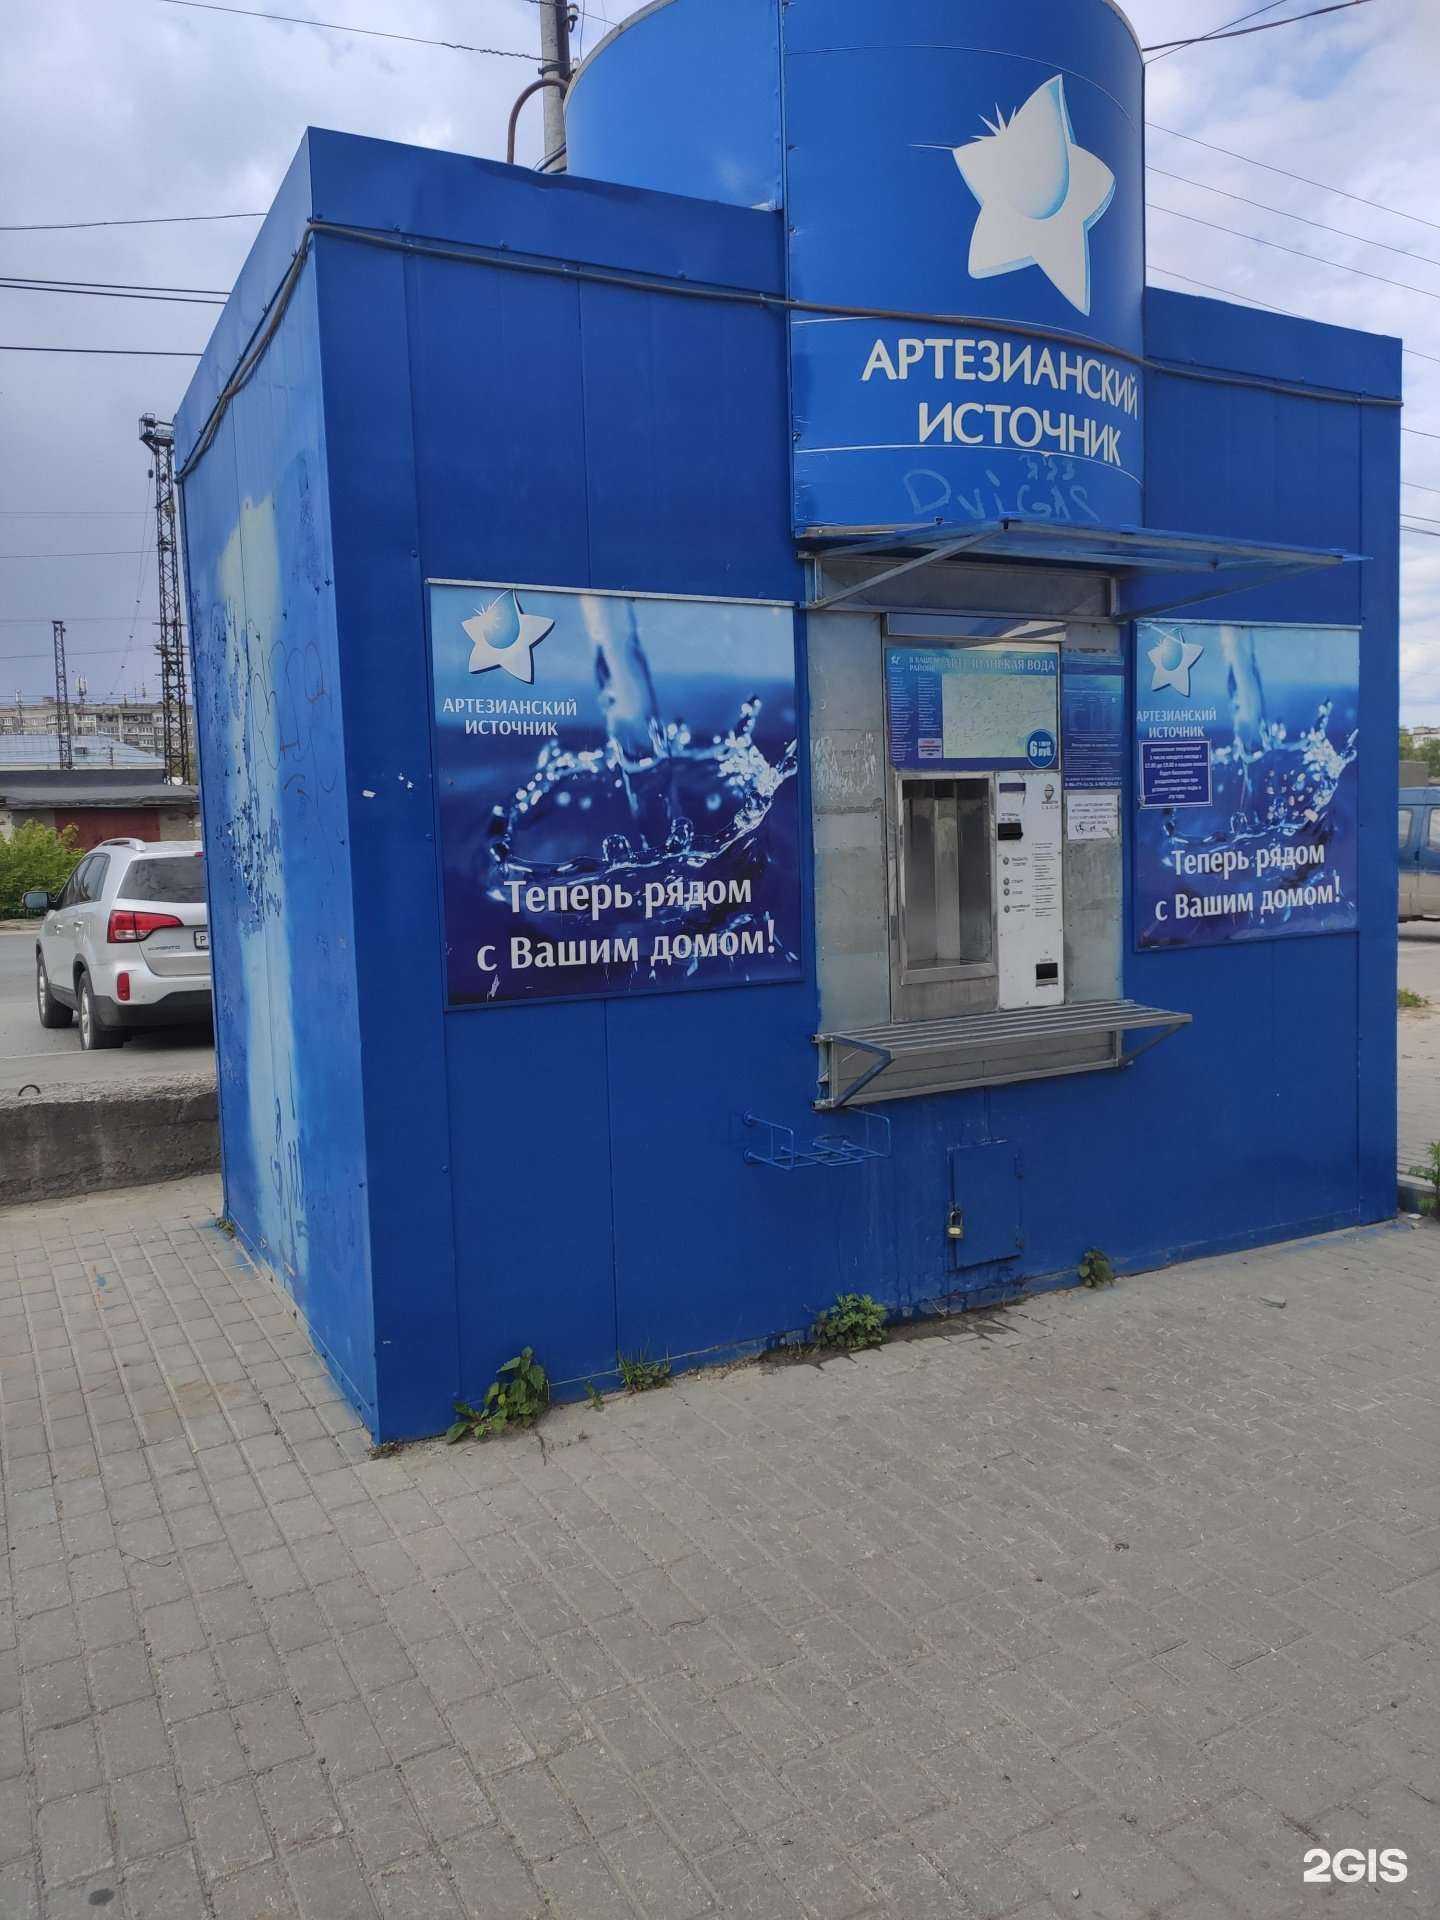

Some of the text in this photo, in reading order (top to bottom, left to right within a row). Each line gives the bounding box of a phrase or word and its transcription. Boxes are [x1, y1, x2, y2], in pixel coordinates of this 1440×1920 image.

[861, 338, 1139, 421] АРТЕЗИАНСКИЙ
[918, 402, 1121, 467] ИСТОЧНИК
[442, 698, 578, 717] АРТЕЗИАНСКИЙ
[1136, 708, 1217, 722] АРТЕЗИАНСКИЙ
[464, 720, 559, 737] ИСТОЧНИК
[1148, 725, 1205, 738] ИСТОЧНИК
[1171, 843, 1325, 879] Теперь рядом
[503, 878, 752, 920] Теперь рядом
[1155, 875, 1341, 921] с Вашим домом!
[476, 919, 776, 971] с Вашим домом!
